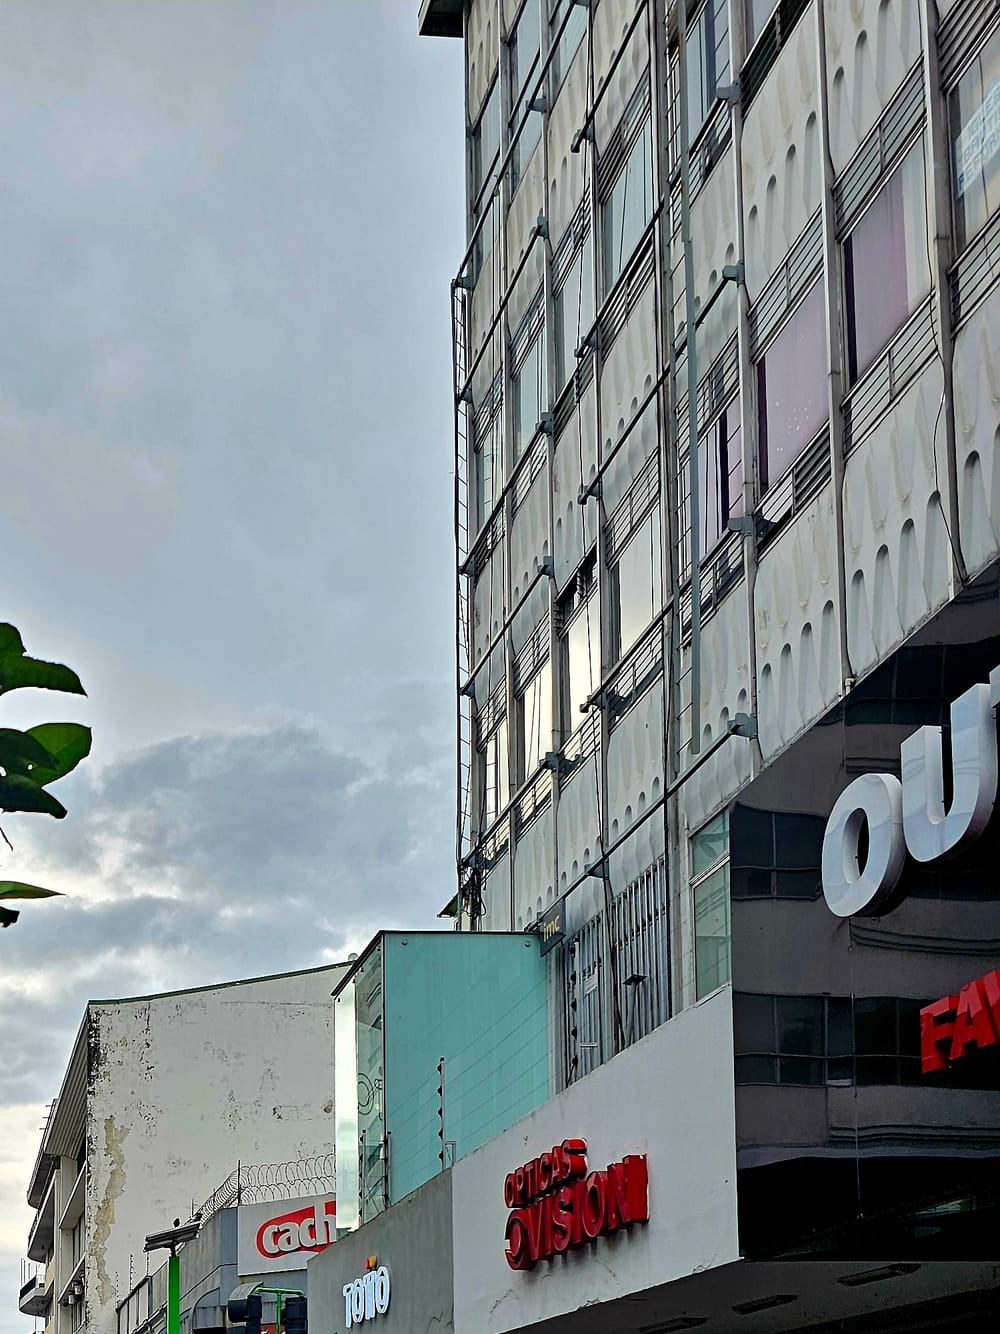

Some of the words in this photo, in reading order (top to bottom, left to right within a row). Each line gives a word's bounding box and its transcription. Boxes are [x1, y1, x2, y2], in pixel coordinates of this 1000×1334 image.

[822, 664, 1000, 917] OU
[504, 1138, 588, 1208] OPTICAS
[527, 1153, 650, 1260] VISION
